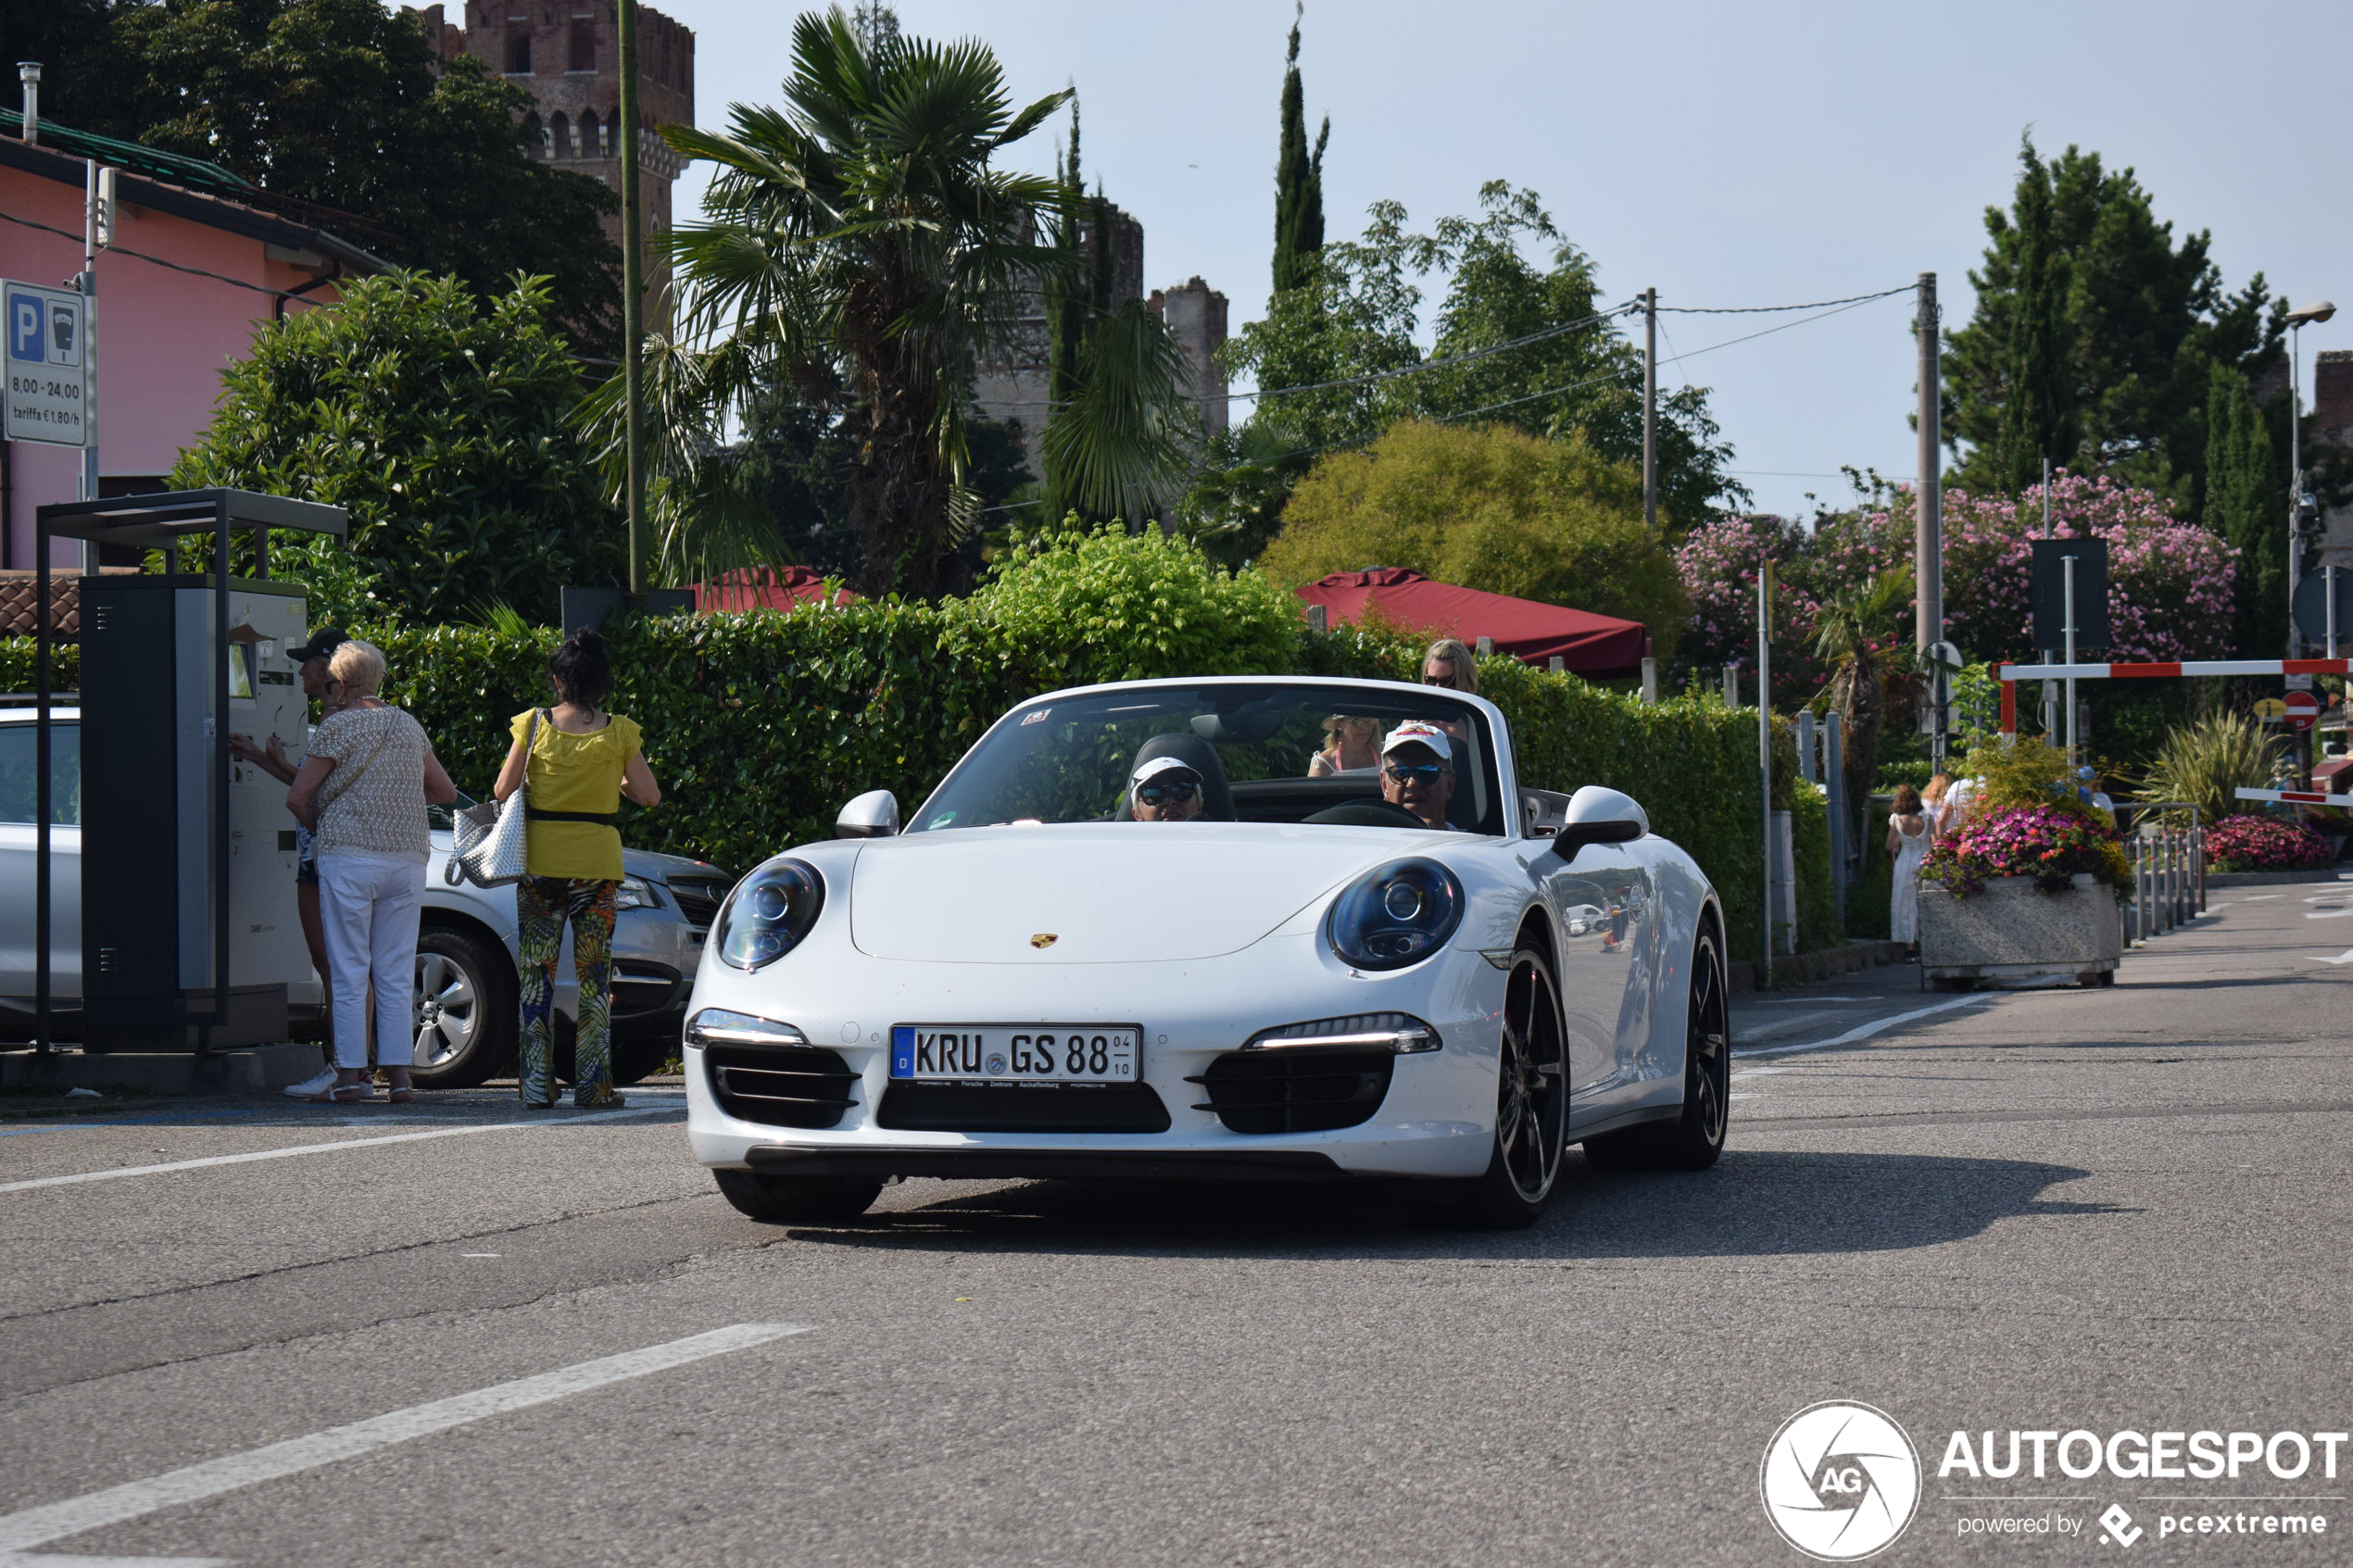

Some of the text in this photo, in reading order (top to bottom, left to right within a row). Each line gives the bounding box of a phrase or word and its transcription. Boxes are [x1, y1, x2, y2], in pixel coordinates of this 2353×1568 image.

[17, 303, 38, 352] P
[14, 406, 42, 420] tariffa
[1113, 1035, 1129, 1047] 04
[915, 1034, 1108, 1074] KRU GS 88
[899, 1058, 907, 1069] D
[1114, 1063, 1129, 1074] 10
[1019, 1081, 1060, 1089] Aschaffenburg
